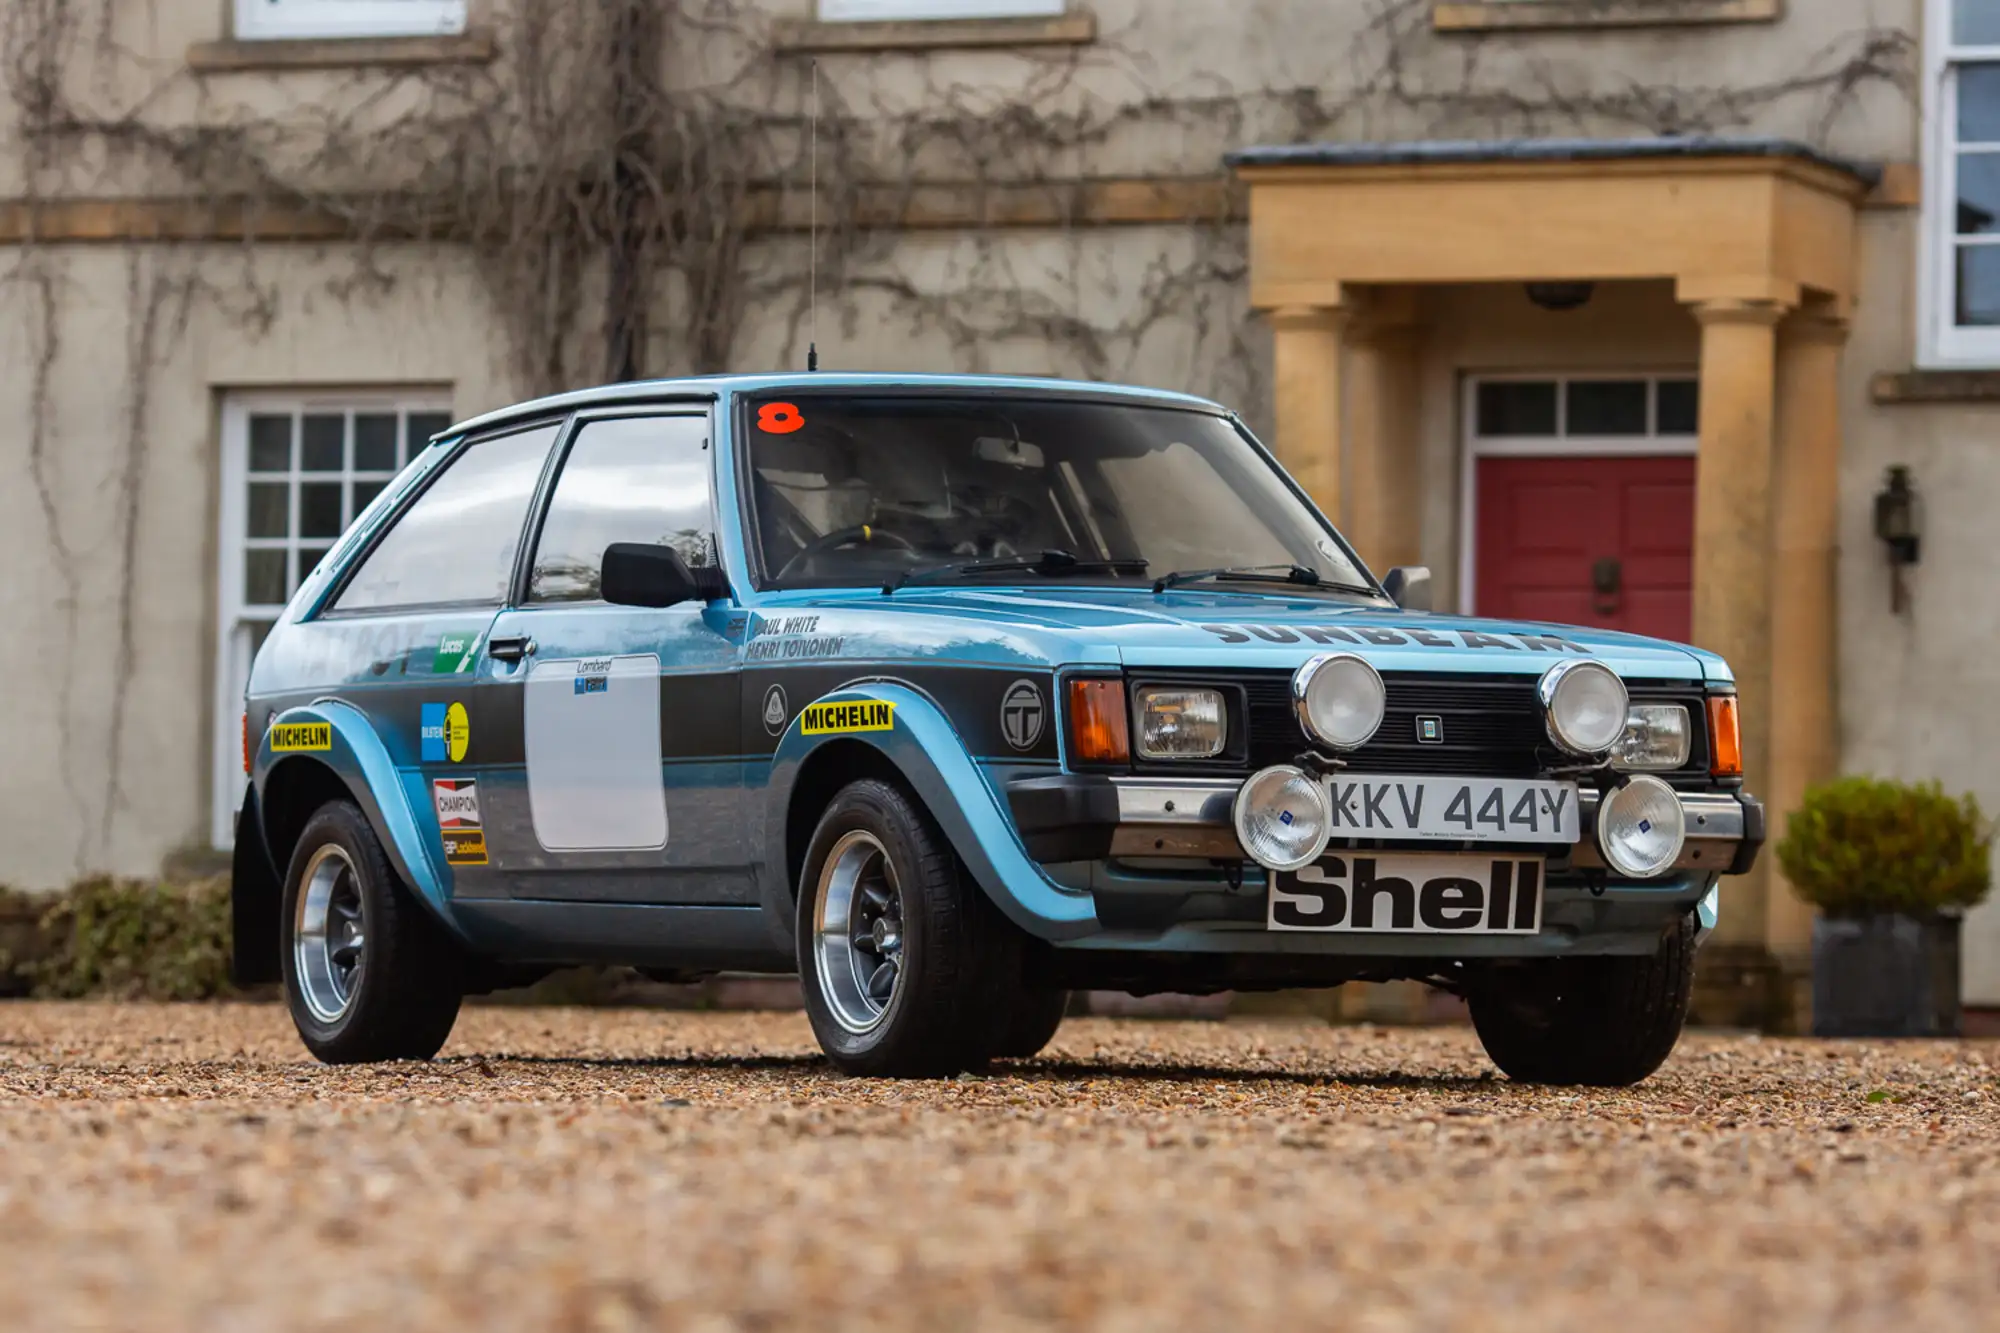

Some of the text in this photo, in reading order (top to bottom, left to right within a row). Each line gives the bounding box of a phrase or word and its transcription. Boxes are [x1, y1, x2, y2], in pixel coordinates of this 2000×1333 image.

[756, 402, 805, 434] 8
[783, 615, 820, 634] WHITE
[439, 636, 465, 654] Lucas
[746, 637, 844, 659] HENRI TOIVONEN
[1200, 624, 1593, 653] SUNBEAM
[576, 659, 612, 673] Lombard
[804, 704, 889, 730] MICHELIN
[272, 727, 329, 747] MICHELIN
[440, 796, 477, 812] CHAMPION
[1330, 782, 1569, 833] KKV 444Y
[1272, 855, 1540, 929] Shell
